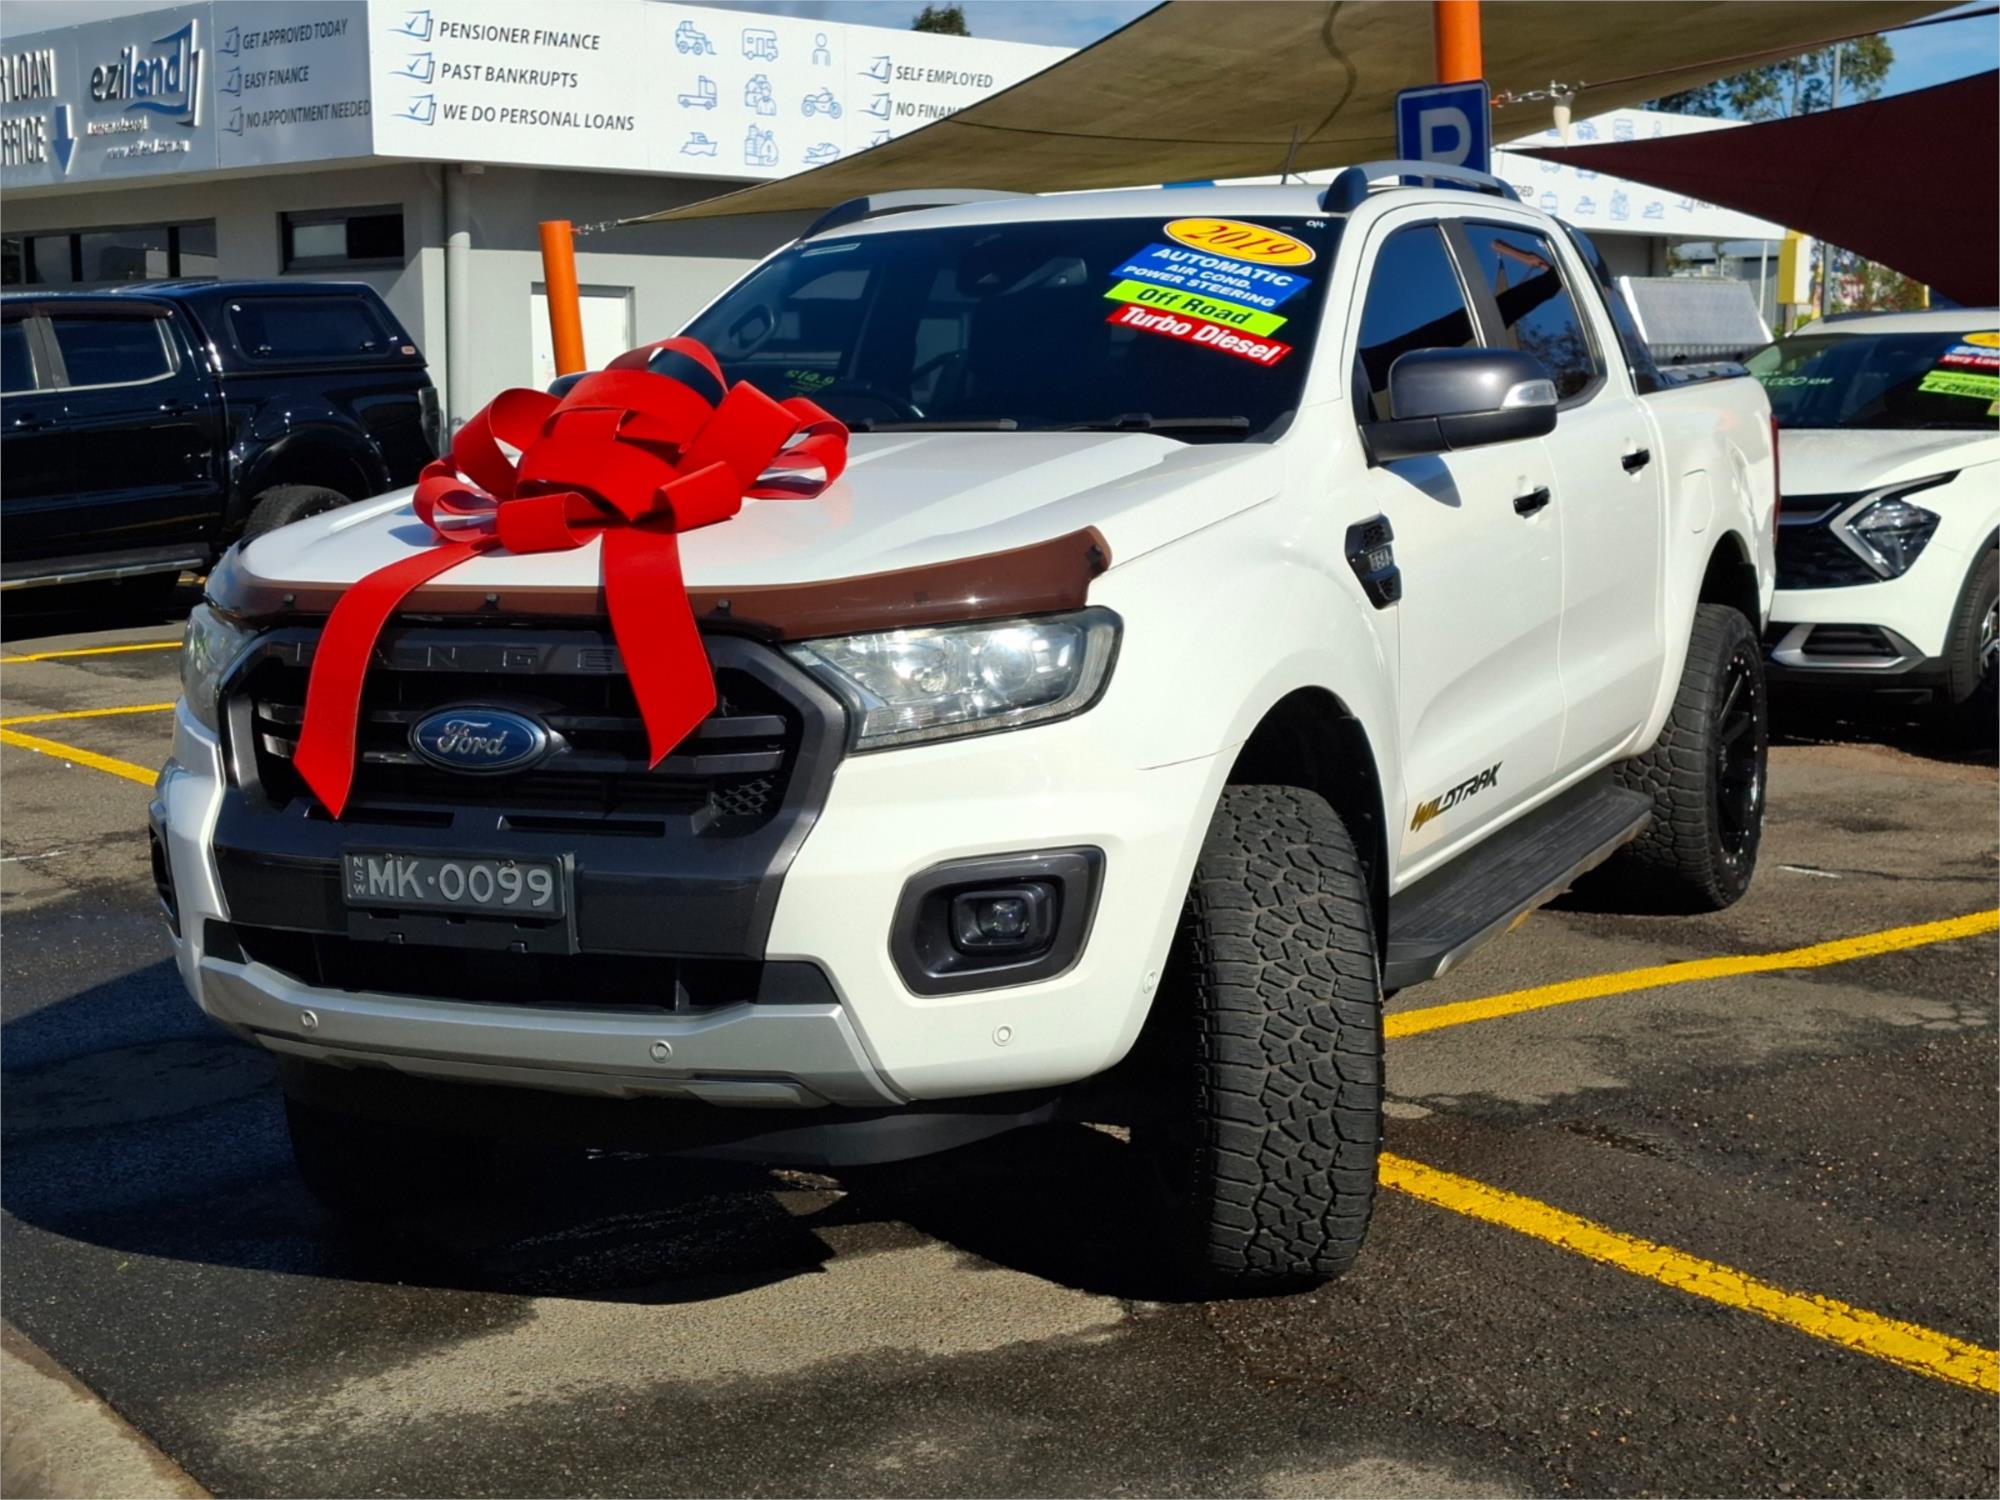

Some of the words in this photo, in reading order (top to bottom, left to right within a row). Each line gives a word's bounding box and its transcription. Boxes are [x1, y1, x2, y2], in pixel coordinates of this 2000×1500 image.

[243, 32, 260, 49] GET
[261, 24, 312, 46] APPROVED
[315, 18, 348, 39] TODAY
[440, 21, 530, 44] PENSIONER
[534, 30, 600, 50] FINANCE
[11, 48, 57, 101] LOAN
[91, 38, 185, 101] ezilend
[245, 73, 267, 89] EASY
[269, 65, 309, 86] FINANCE
[441, 63, 482, 79] PAST
[485, 67, 578, 88] BANKRUPTS
[896, 66, 924, 81] SELF
[927, 69, 993, 88] EMPLOYED
[247, 112, 260, 128] NO
[261, 103, 329, 126] APPOINTMENT
[331, 99, 371, 118] NEEDED
[443, 104, 467, 120] WE
[471, 106, 496, 122] DO
[500, 107, 580, 127] PERSONAL
[585, 113, 634, 131] LOANS
[896, 102, 915, 117] NO
[918, 104, 965, 119] FINAN
[0, 115, 48, 166] FFICE
[1419, 106, 1472, 188] P
[1183, 225, 1298, 256] 2019
[1152, 248, 1293, 287] AUTOMATIC
[1167, 264, 1196, 276] AIR
[1200, 270, 1251, 289] COND.
[1124, 265, 1186, 284] POWER
[1187, 278, 1276, 308] STEERING
[1137, 288, 1180, 306] Off
[1181, 296, 1253, 325] Road
[1121, 306, 1192, 336] Turbo
[1193, 325, 1281, 361] Diesel
[437, 719, 508, 755] Ford
[1410, 760, 1503, 833] WILDTRAK
[352, 856, 366, 894] NSW
